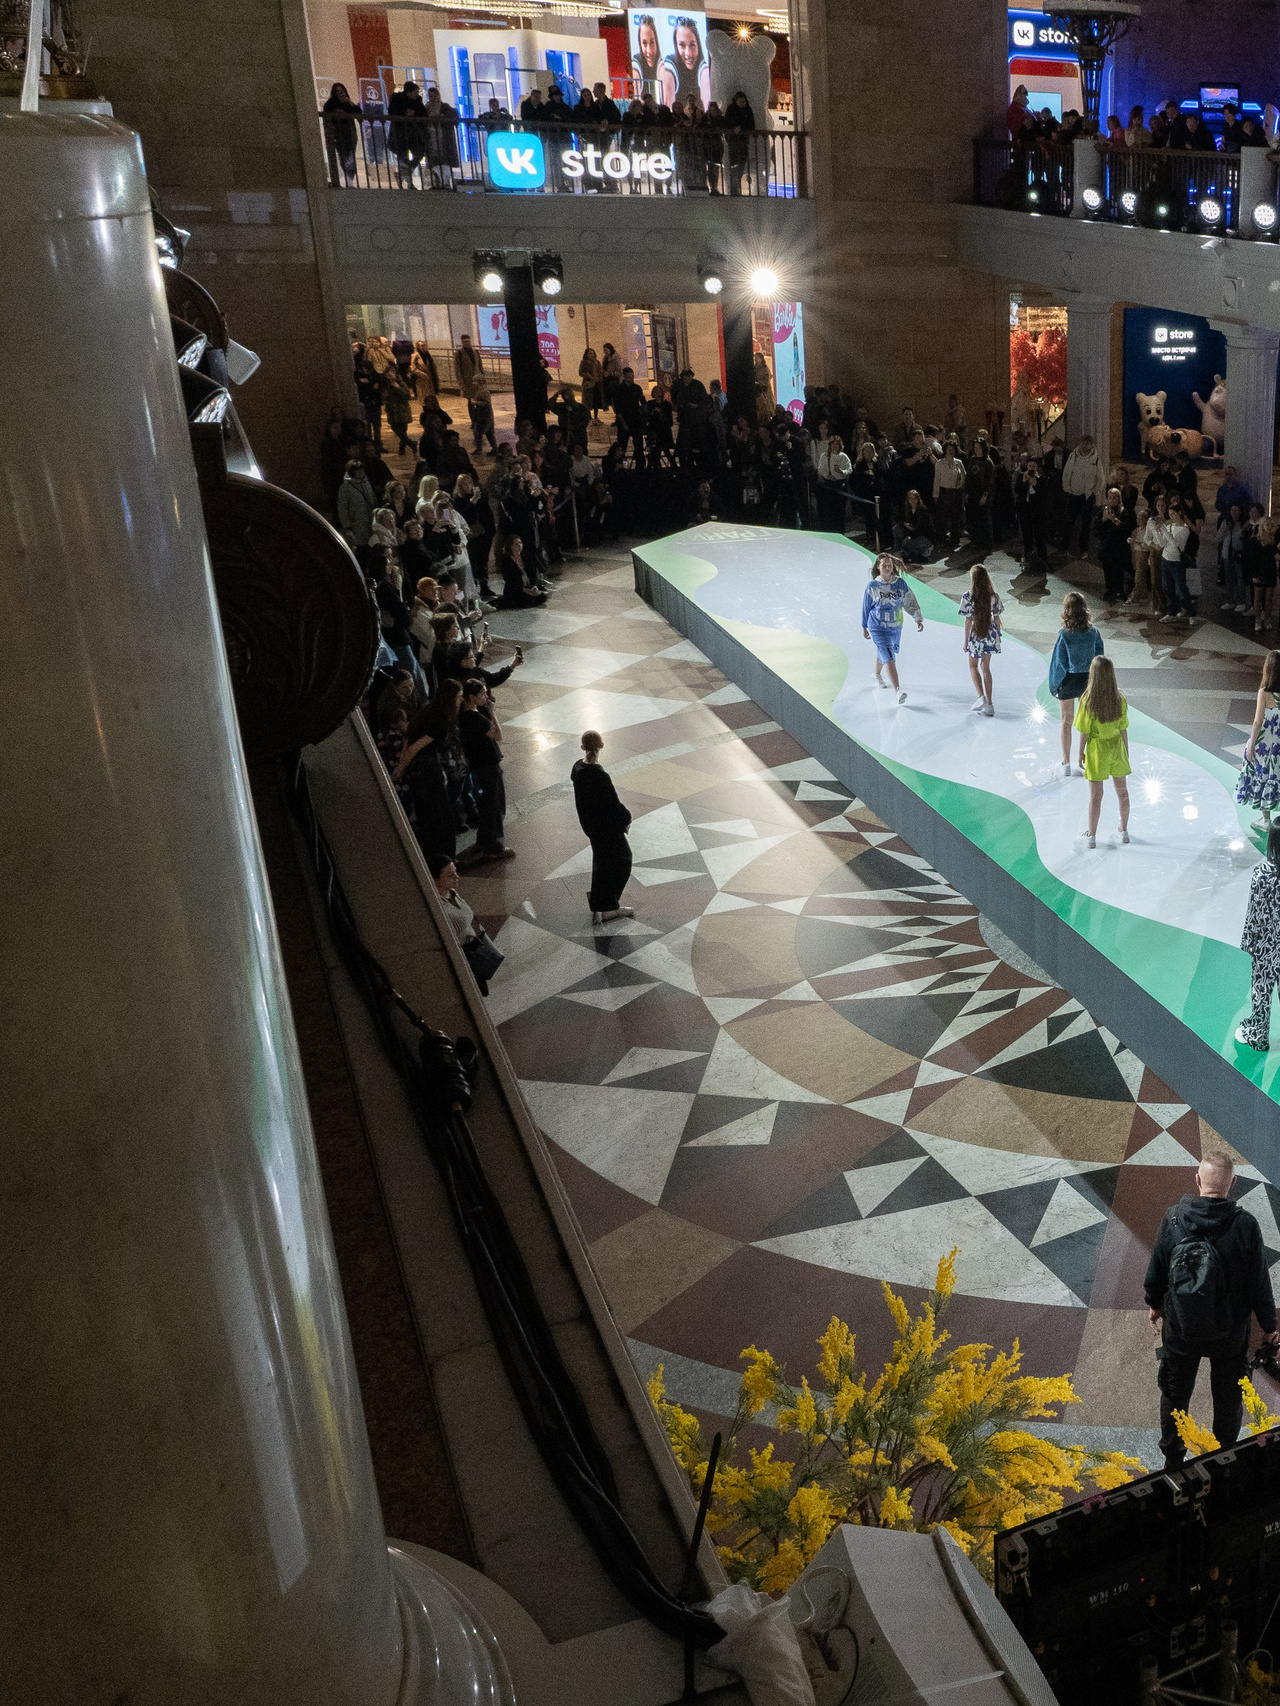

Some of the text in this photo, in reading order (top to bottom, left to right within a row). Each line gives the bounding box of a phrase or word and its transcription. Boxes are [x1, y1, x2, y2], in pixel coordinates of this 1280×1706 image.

[496, 143, 673, 180] VK store
[1170, 330, 1194, 339] store
